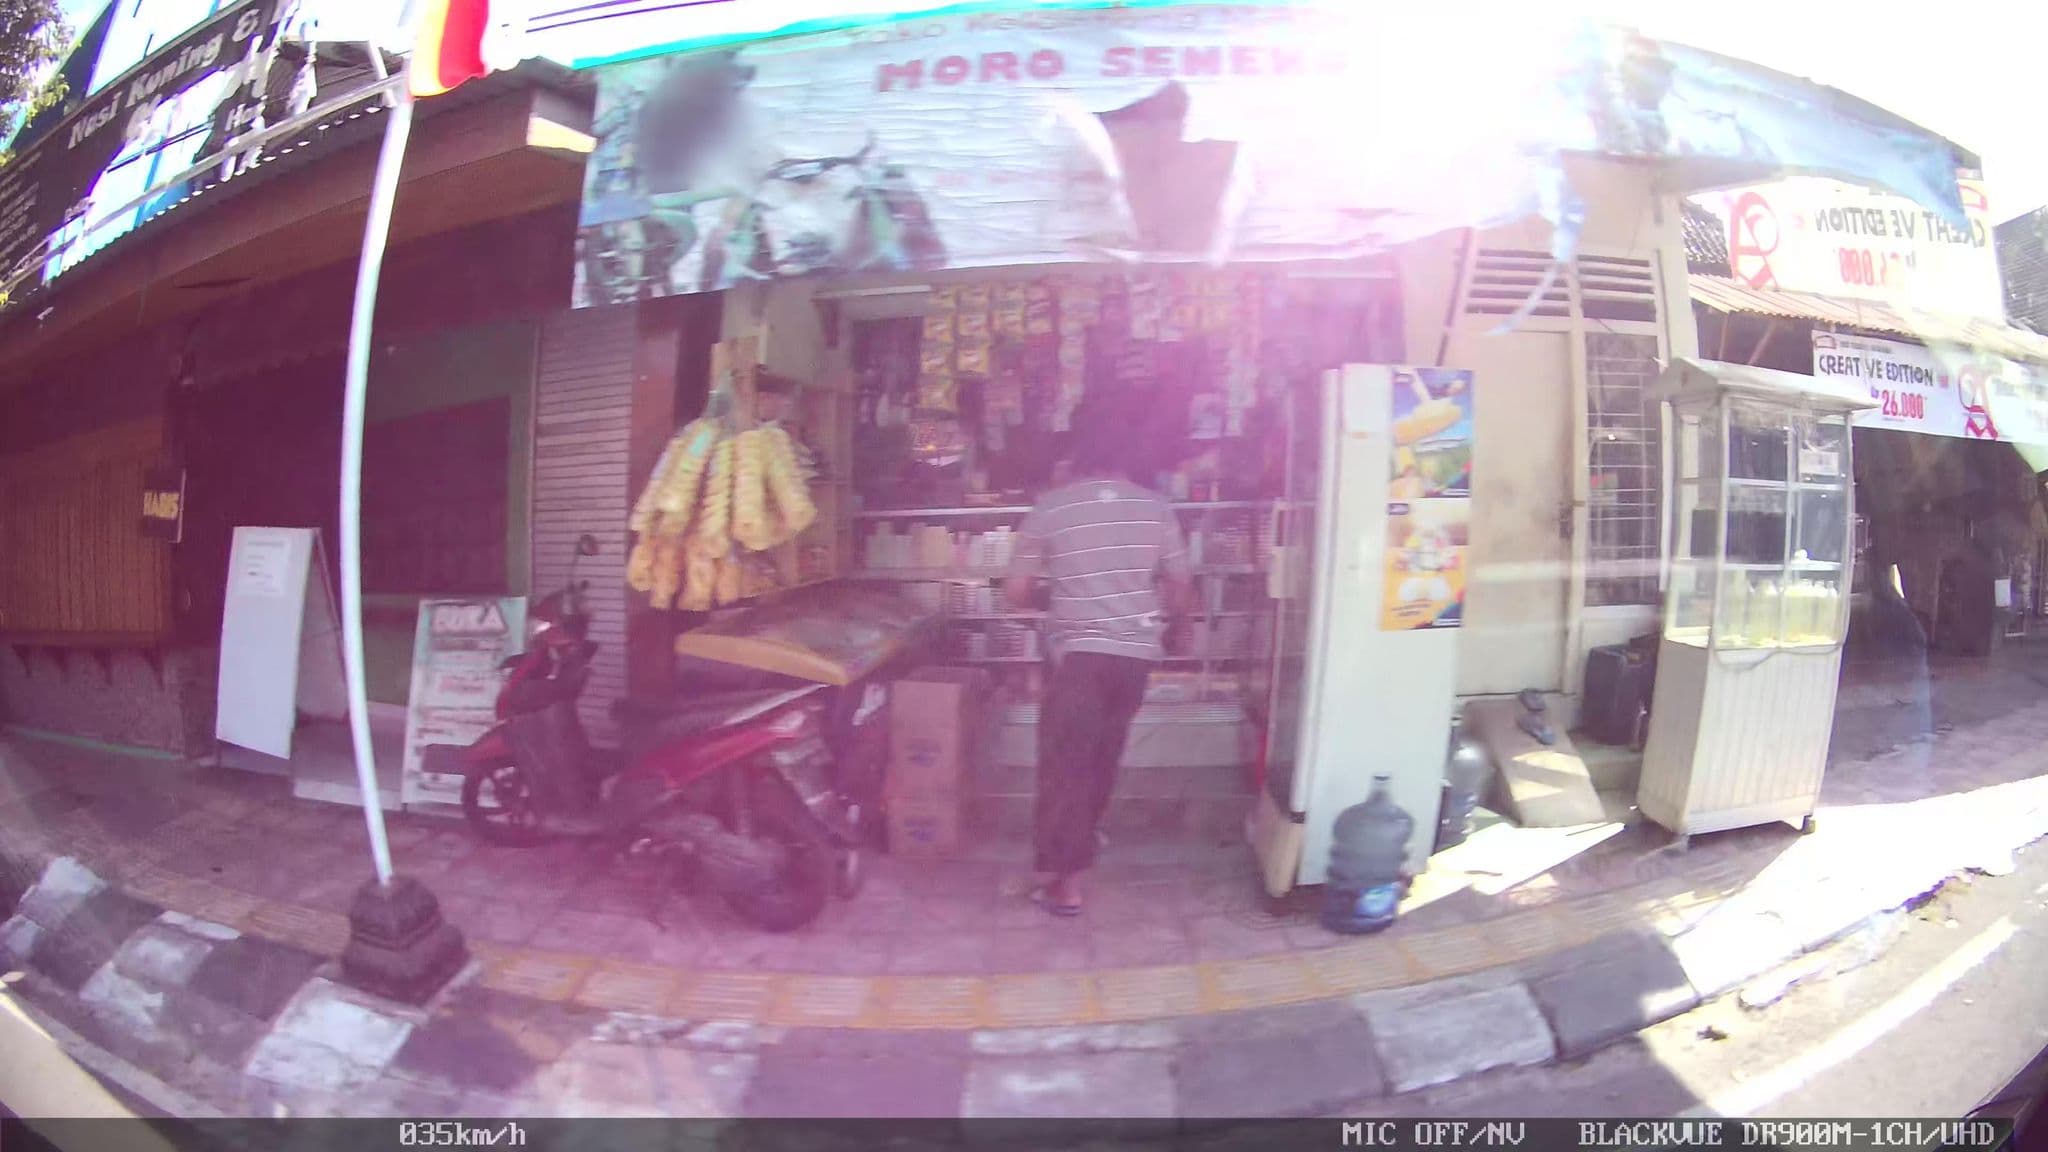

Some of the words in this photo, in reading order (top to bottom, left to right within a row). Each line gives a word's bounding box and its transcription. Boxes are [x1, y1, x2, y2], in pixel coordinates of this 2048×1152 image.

[877, 49, 1064, 92] MORO
[67, 91, 123, 149] Nasi
[126, 33, 225, 107] Kuning
[1886, 361, 1934, 387] EDITION
[1882, 389, 1924, 419] 26.000
